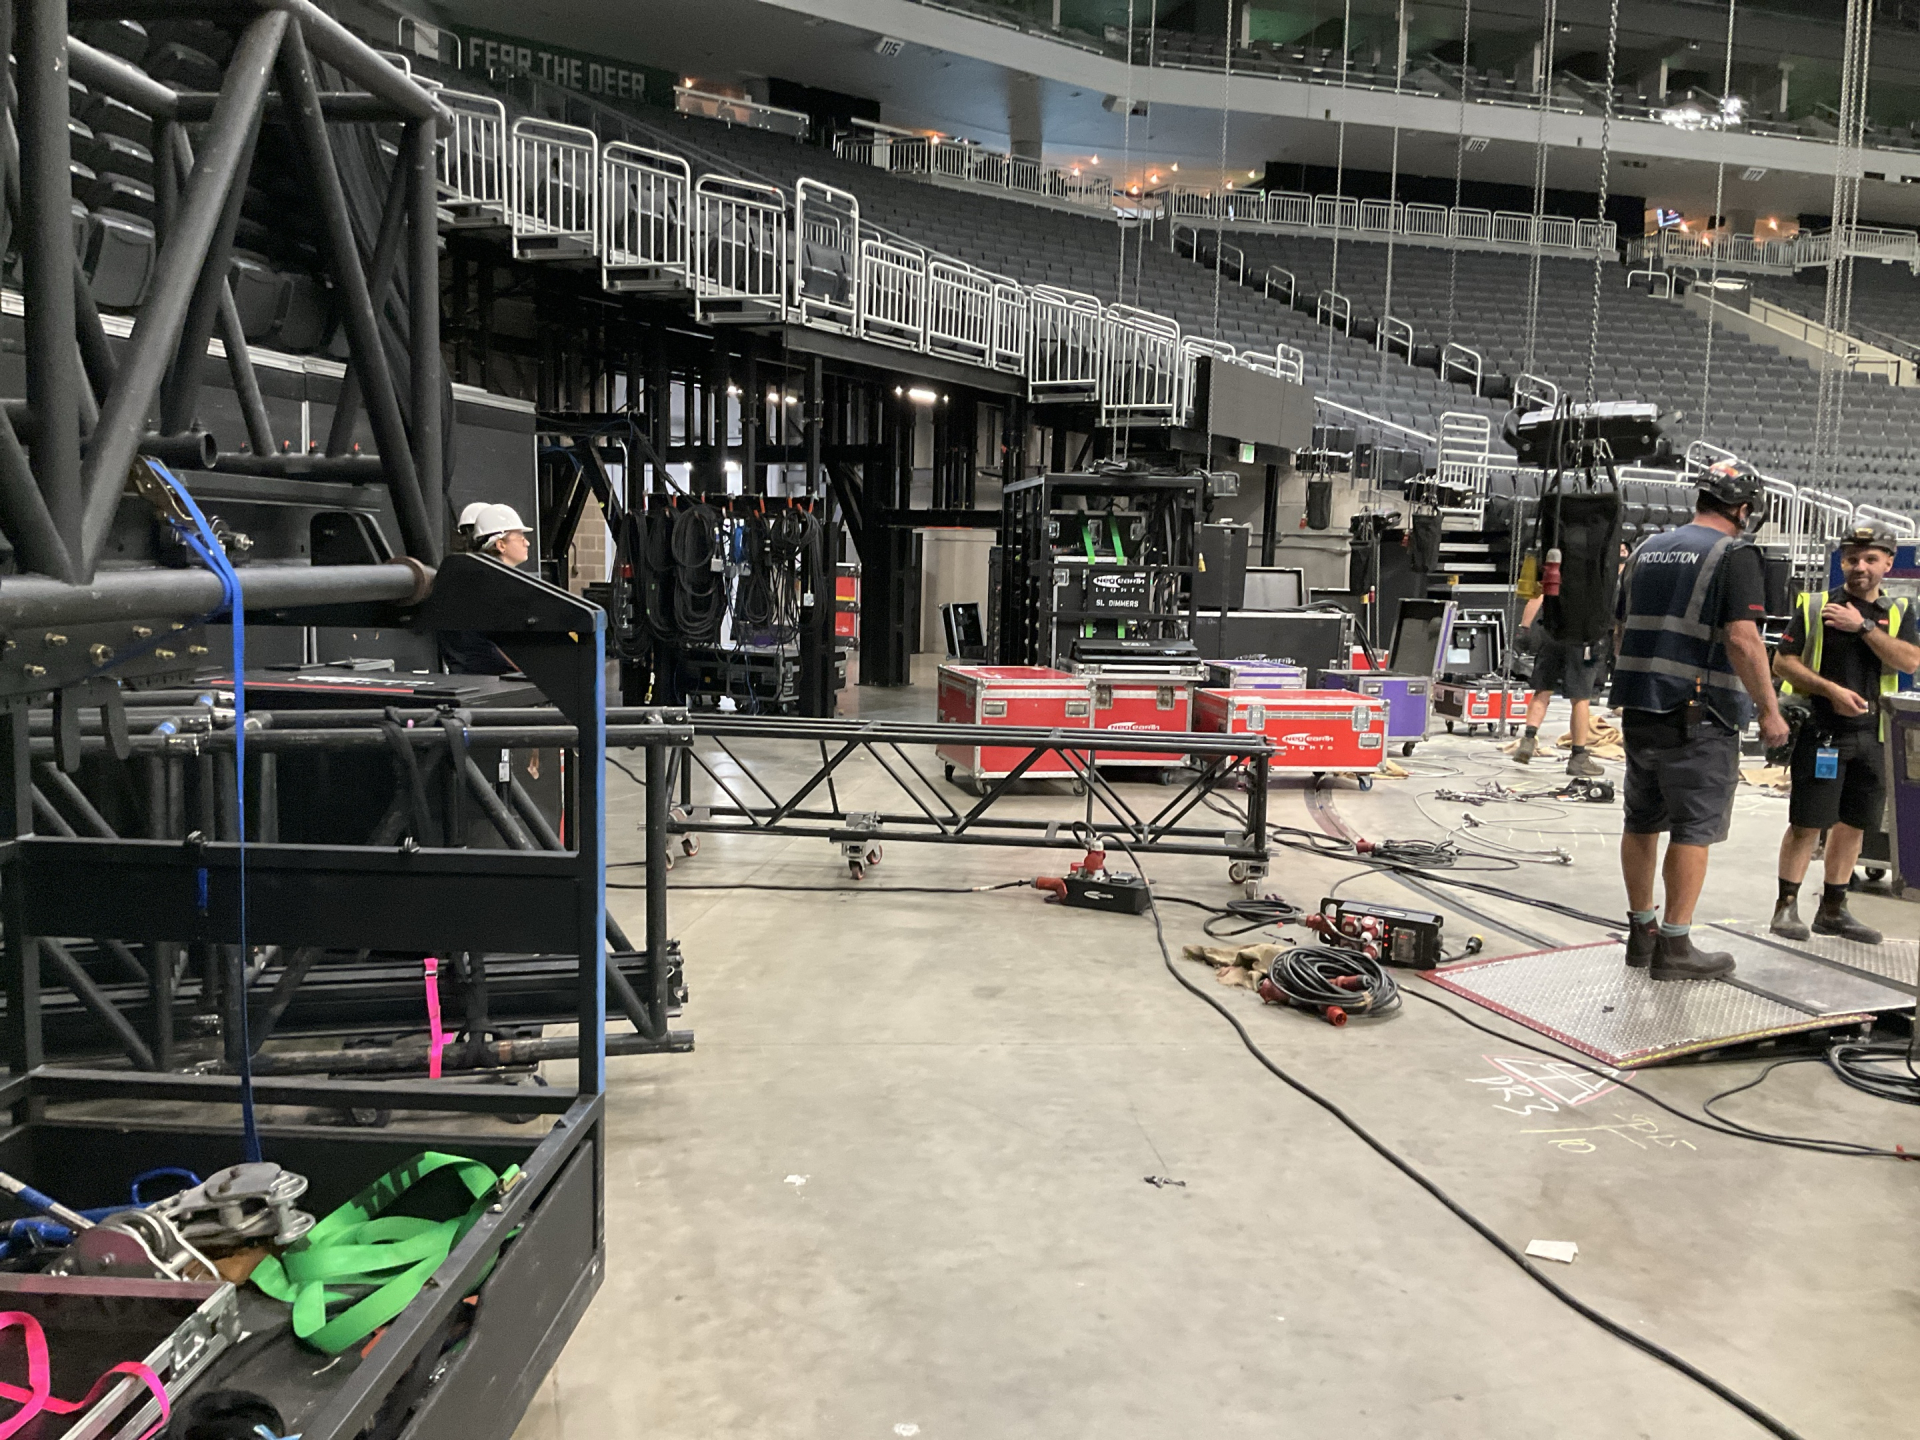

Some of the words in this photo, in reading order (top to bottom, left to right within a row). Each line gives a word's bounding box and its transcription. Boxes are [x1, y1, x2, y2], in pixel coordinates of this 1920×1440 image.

[880, 40, 901, 56] 115
[469, 37, 532, 77] FEAR
[538, 51, 582, 89] THE
[589, 62, 645, 99] DEER
[1637, 551, 1700, 564] PRODUCTION
[1108, 599, 1139, 608] DIMMERS
[350, 1151, 426, 1220] TAIT
